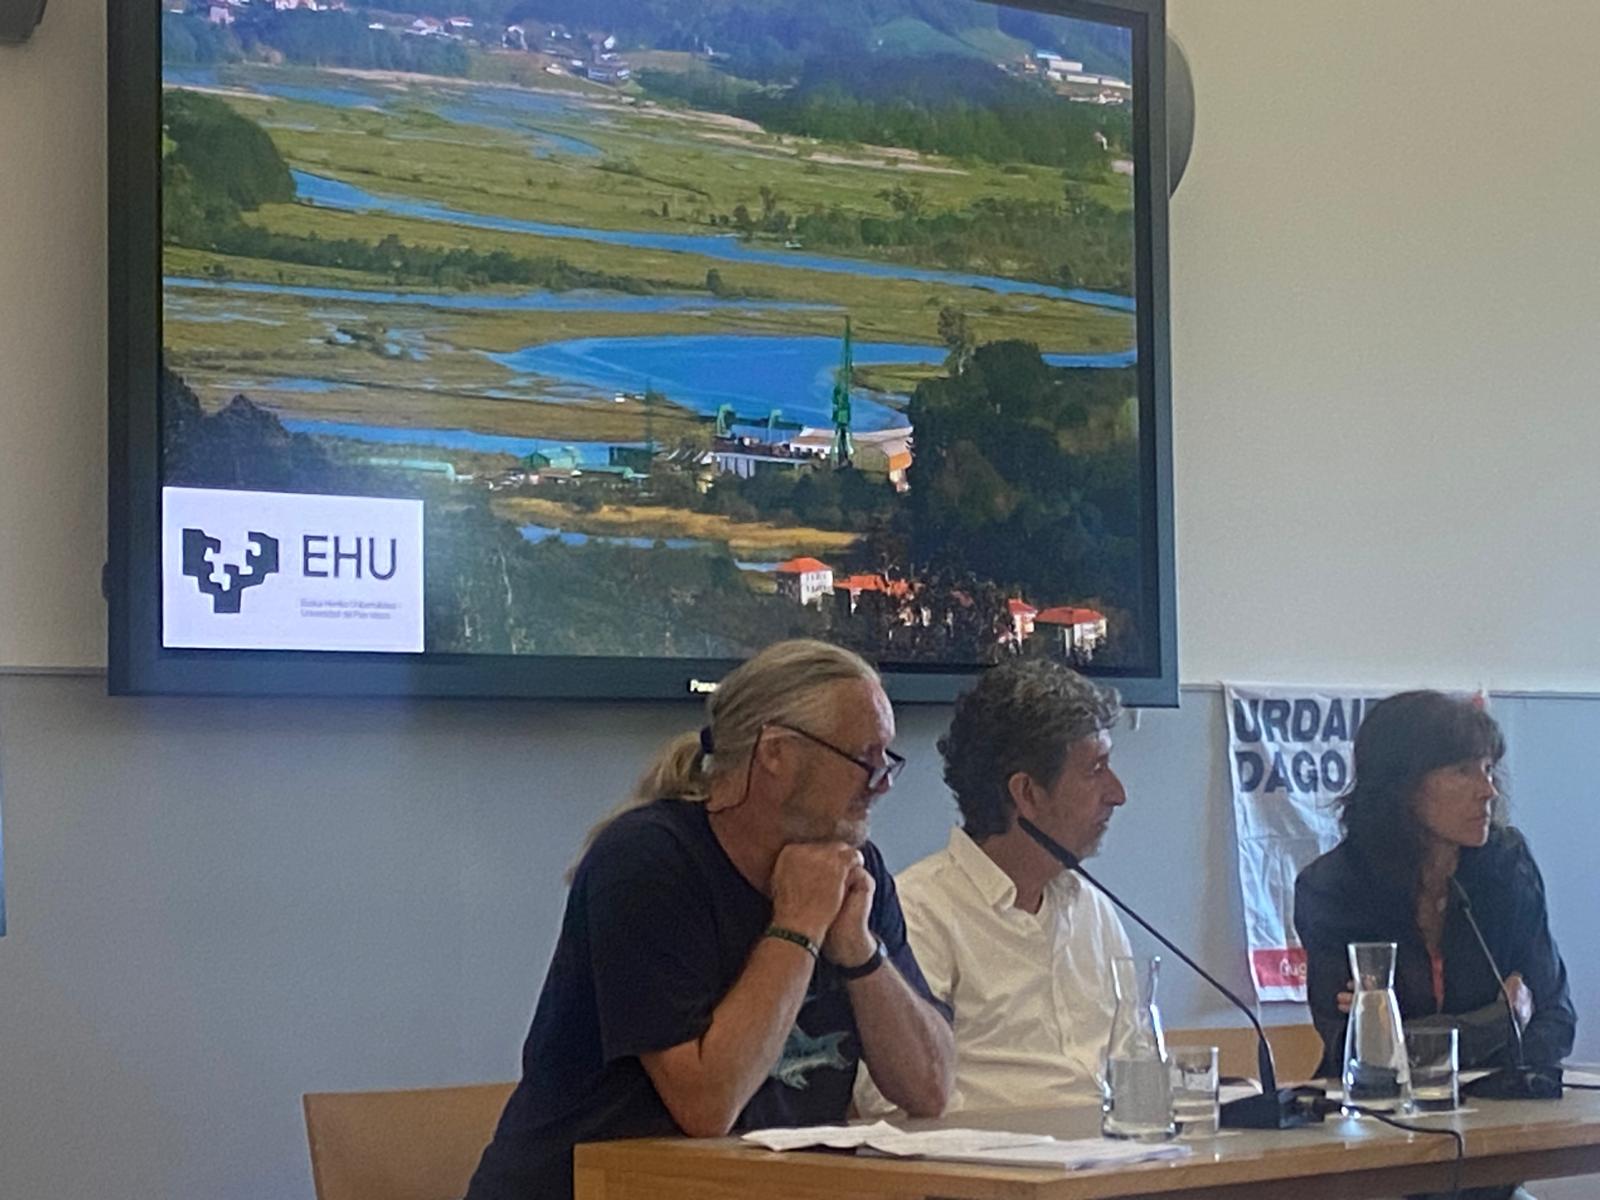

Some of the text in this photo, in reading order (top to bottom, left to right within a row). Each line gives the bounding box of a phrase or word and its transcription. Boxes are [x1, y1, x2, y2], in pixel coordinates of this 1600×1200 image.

[303, 534, 397, 580] EHU
[1233, 698, 1377, 742] URDAI
[1235, 750, 1346, 793] DAGO
